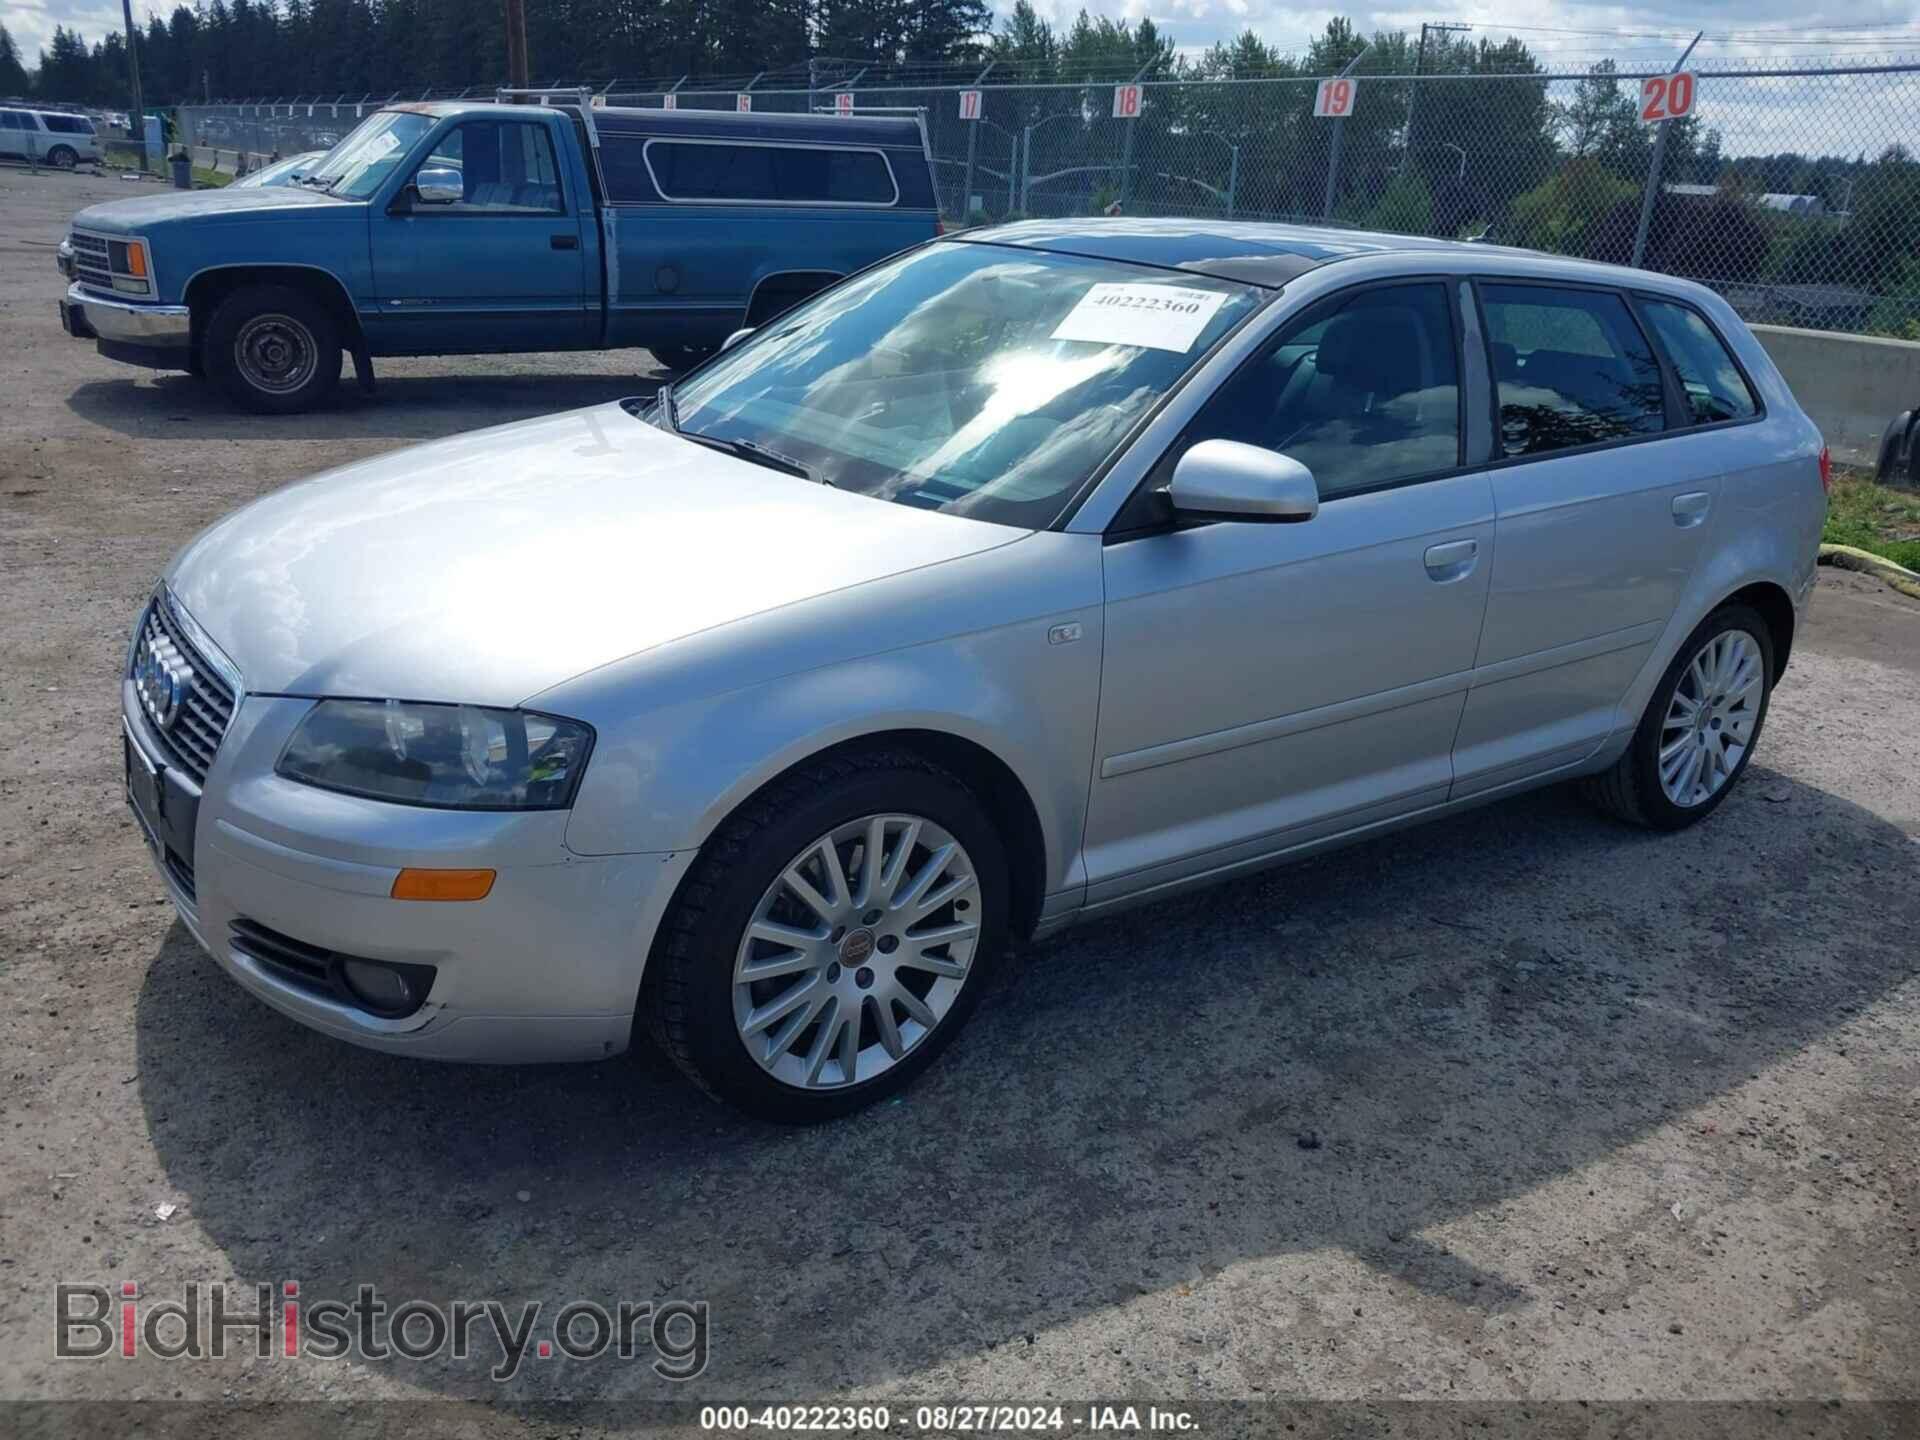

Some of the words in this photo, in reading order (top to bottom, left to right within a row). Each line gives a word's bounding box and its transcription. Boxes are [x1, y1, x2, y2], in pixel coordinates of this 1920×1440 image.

[964, 92, 977, 117] 17
[1119, 87, 1137, 114] 18
[1323, 81, 1350, 114] 19
[1643, 74, 1693, 121] 20
[1094, 295, 1200, 314] 40222360
